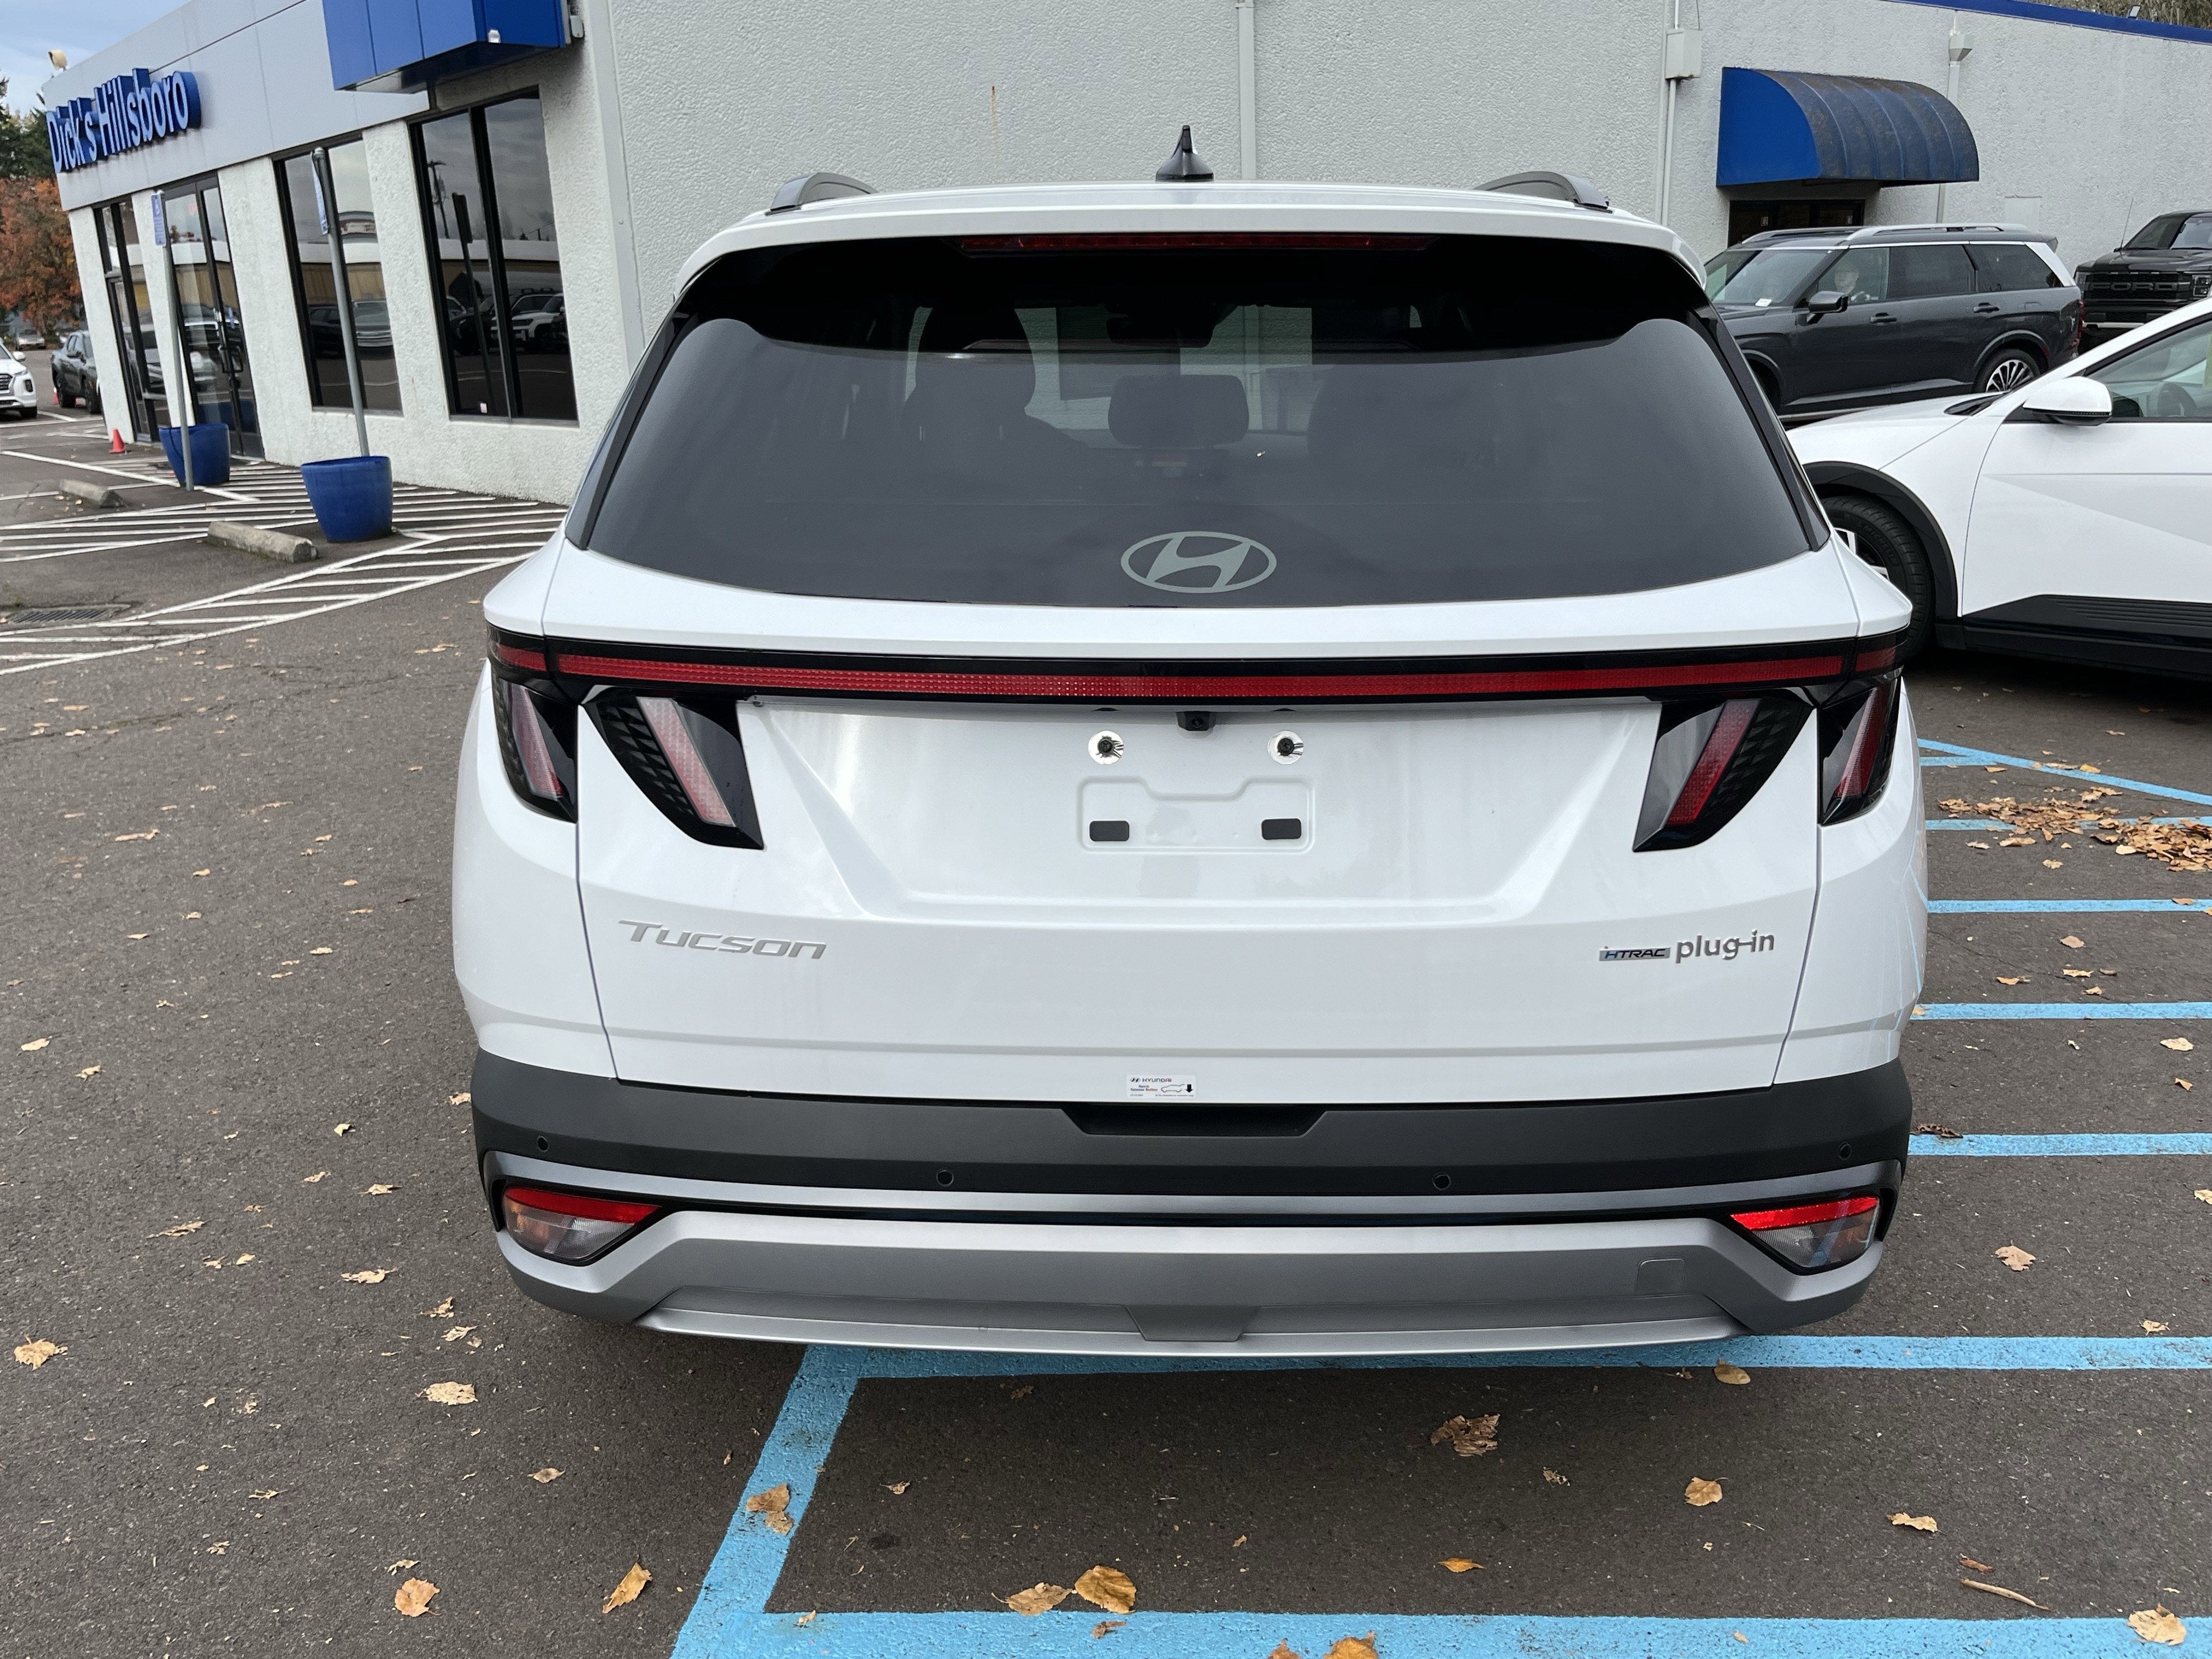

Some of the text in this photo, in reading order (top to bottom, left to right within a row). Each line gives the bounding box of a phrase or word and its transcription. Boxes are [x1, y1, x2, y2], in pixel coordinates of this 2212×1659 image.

[46, 68, 192, 174] Dick's Hillsboro
[1604, 929, 1775, 964] HTRAC plug-in
